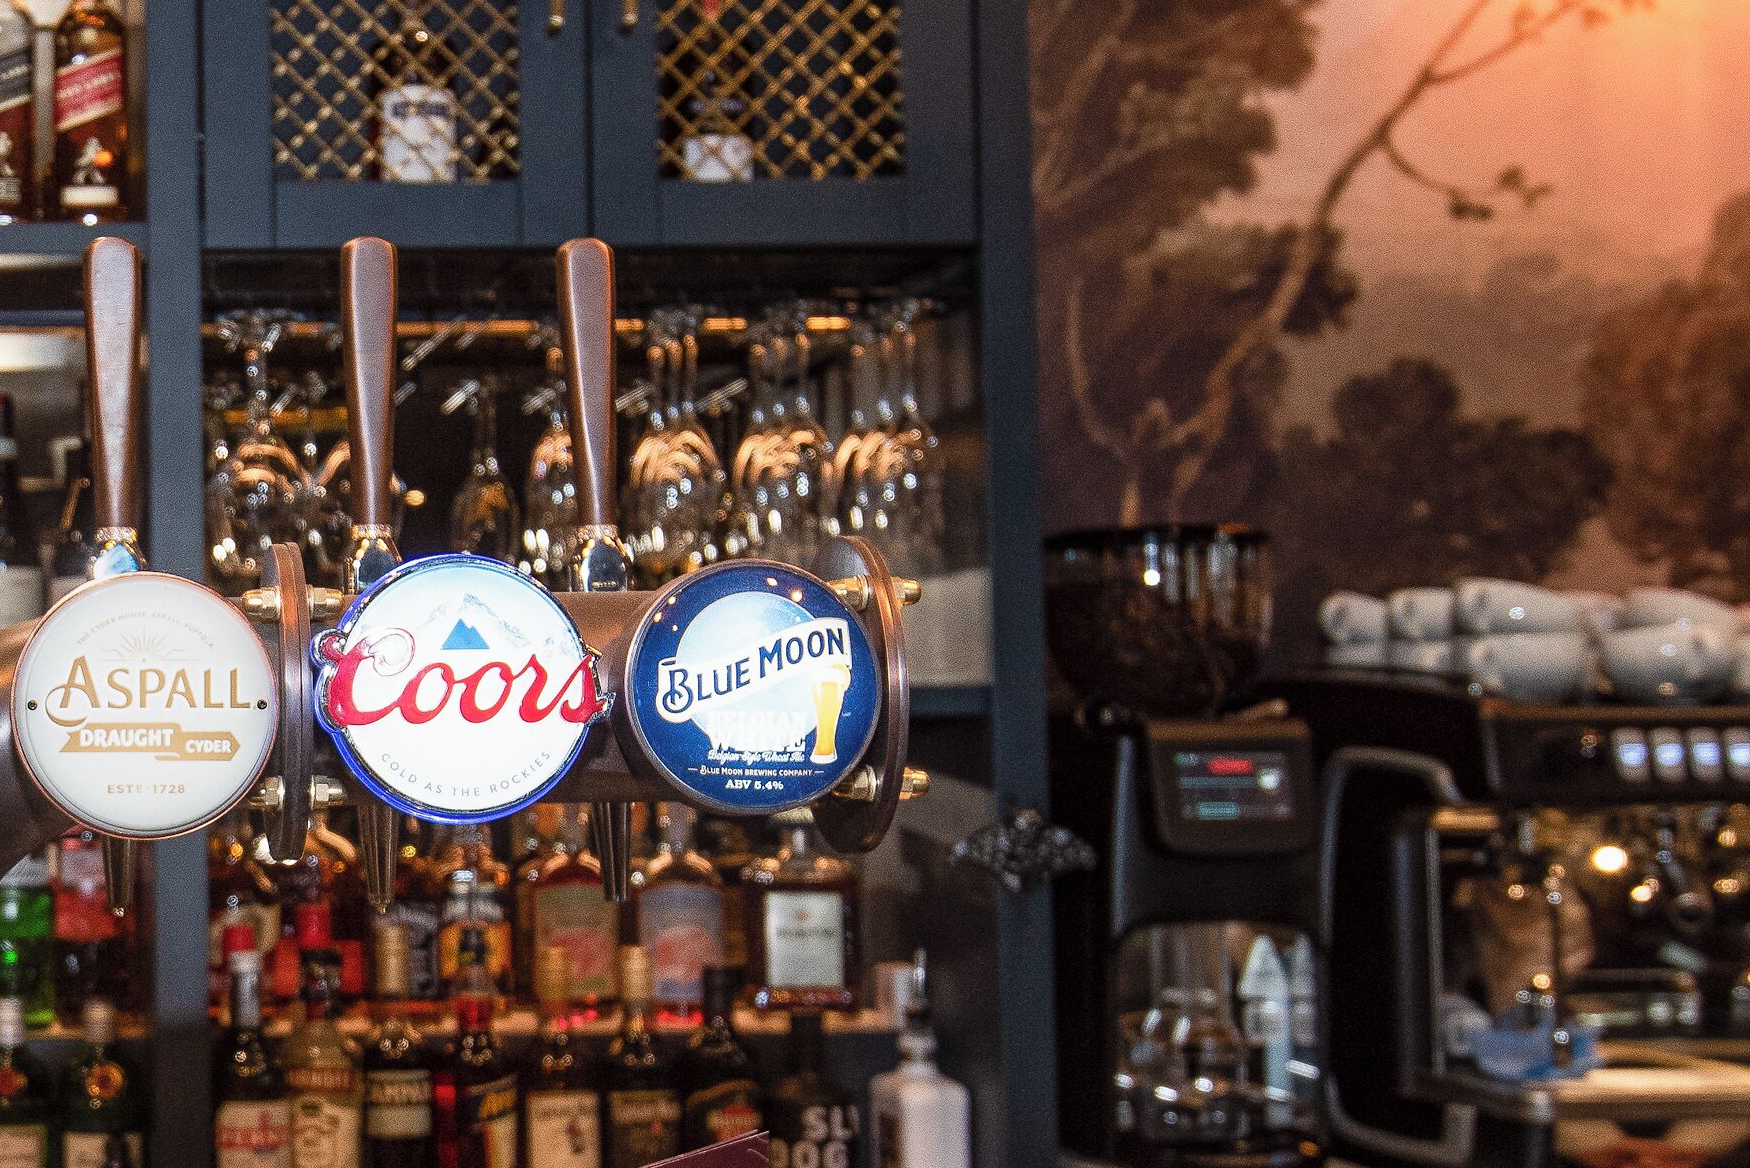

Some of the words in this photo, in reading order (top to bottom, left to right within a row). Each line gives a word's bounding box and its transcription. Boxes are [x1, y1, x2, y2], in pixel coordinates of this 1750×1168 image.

[321, 627, 605, 725] Coors
[78, 728, 174, 748] DRAUGHT
[185, 739, 232, 753] CYDER
[381, 752, 418, 785] COLD
[424, 782, 443, 794] AS
[452, 786, 481, 797] THE
[489, 750, 551, 793] ROCKIES
[744, 769, 778, 777] BREWING
[779, 769, 813, 777] COMPANY
[152, 783, 186, 794] 1728
[725, 779, 752, 789] ABV
[753, 780, 784, 790] 5.4%
